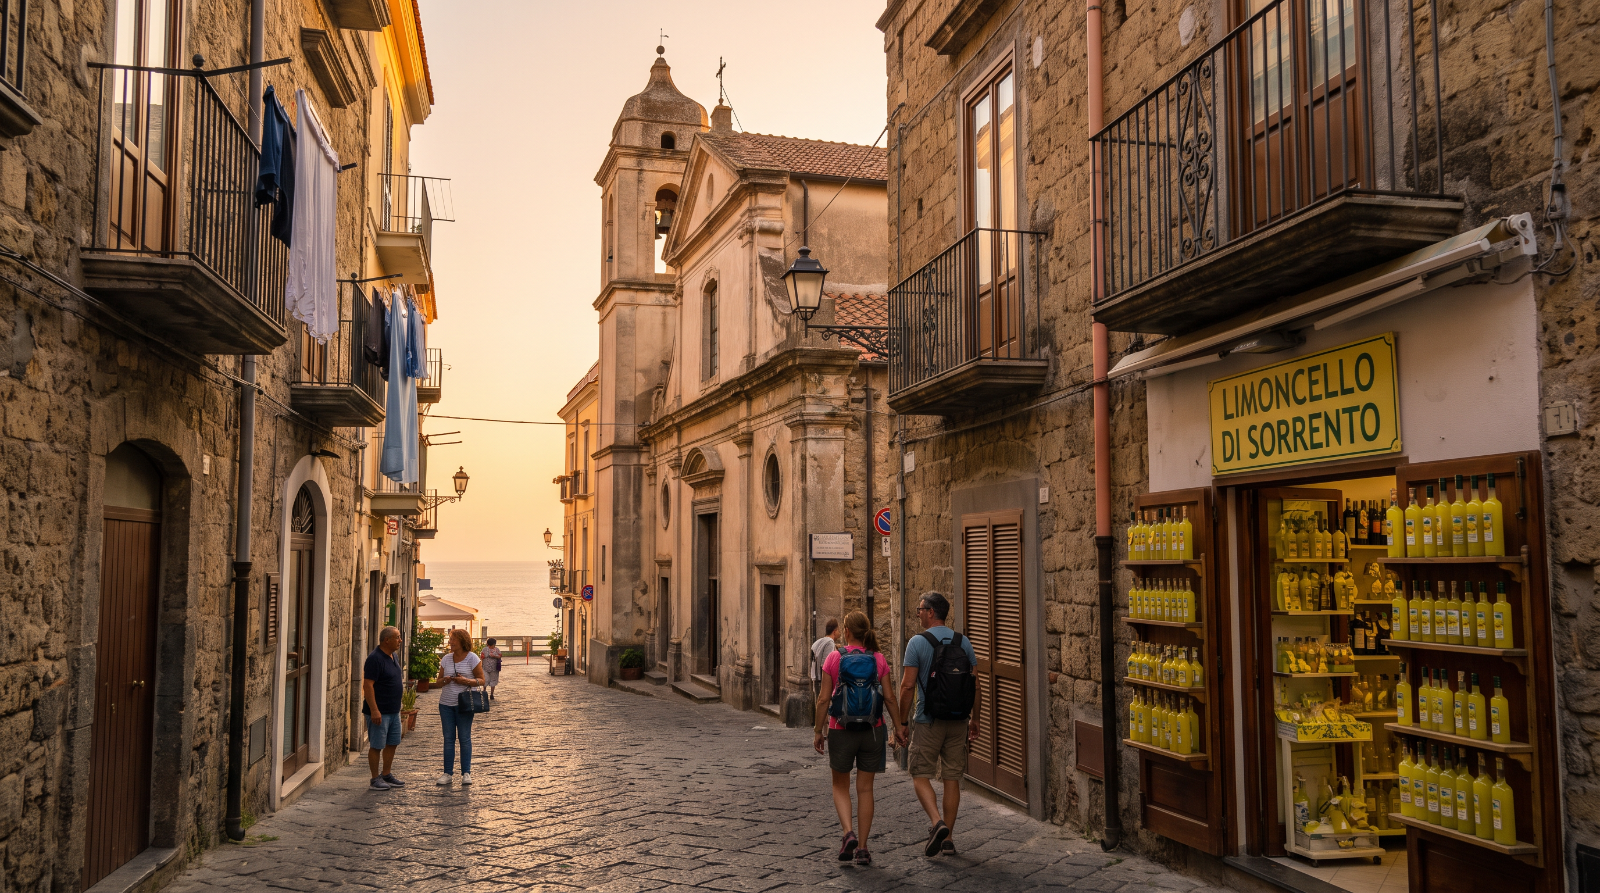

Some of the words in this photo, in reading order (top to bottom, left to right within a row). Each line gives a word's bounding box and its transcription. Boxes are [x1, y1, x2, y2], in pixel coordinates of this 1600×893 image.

[1222, 352, 1375, 420] LIMONCELLO
[1222, 428, 1241, 463] DI
[1247, 402, 1381, 460] SORRENTO
